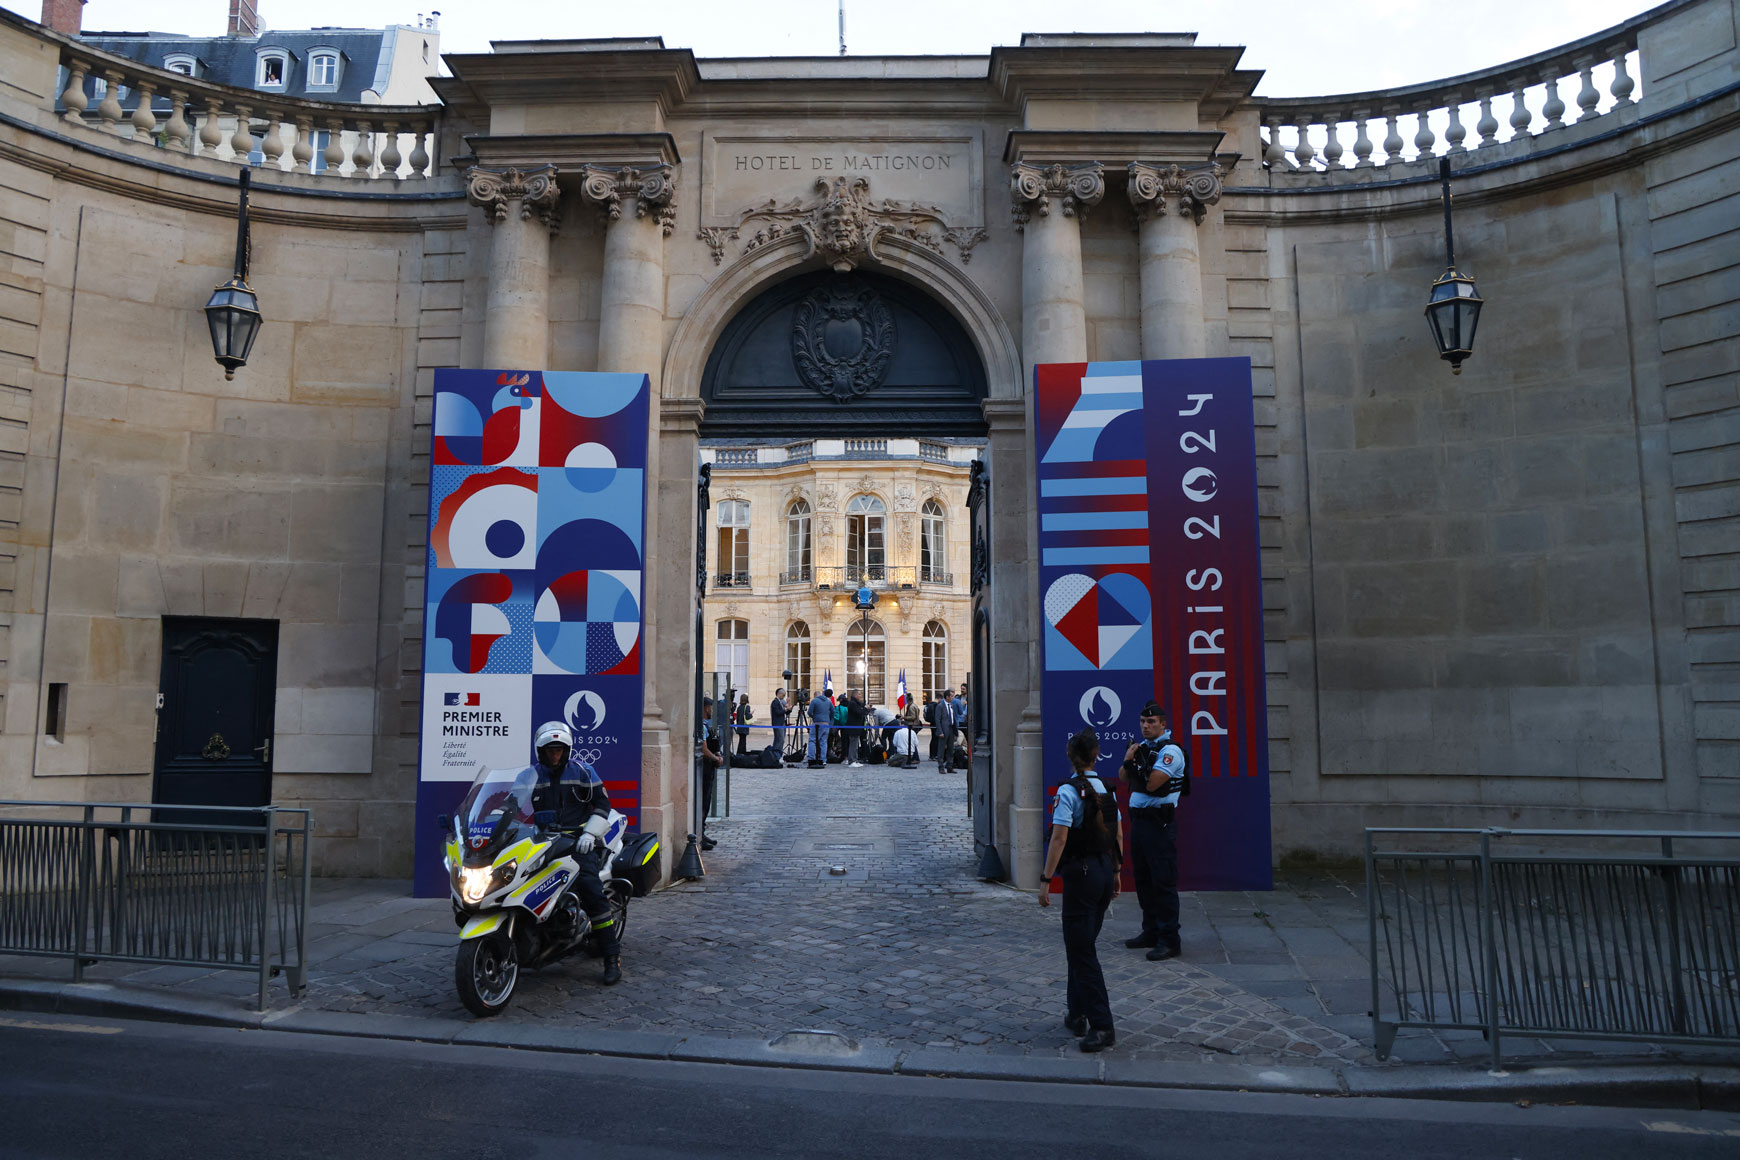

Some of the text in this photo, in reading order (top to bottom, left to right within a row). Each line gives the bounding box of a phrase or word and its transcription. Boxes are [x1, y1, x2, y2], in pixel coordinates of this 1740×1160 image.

[735, 155, 952, 171] HOTEL DE MATIGNON
[442, 711, 502, 723] PREMIER
[442, 725, 509, 737] MINISTRE
[588, 736, 618, 744] 2024
[1104, 732, 1135, 740] 2024
[442, 741, 467, 749] Liberté
[442, 750, 467, 759] Égalité
[469, 826, 492, 834] POLICE
[535, 875, 556, 895] POLICE
